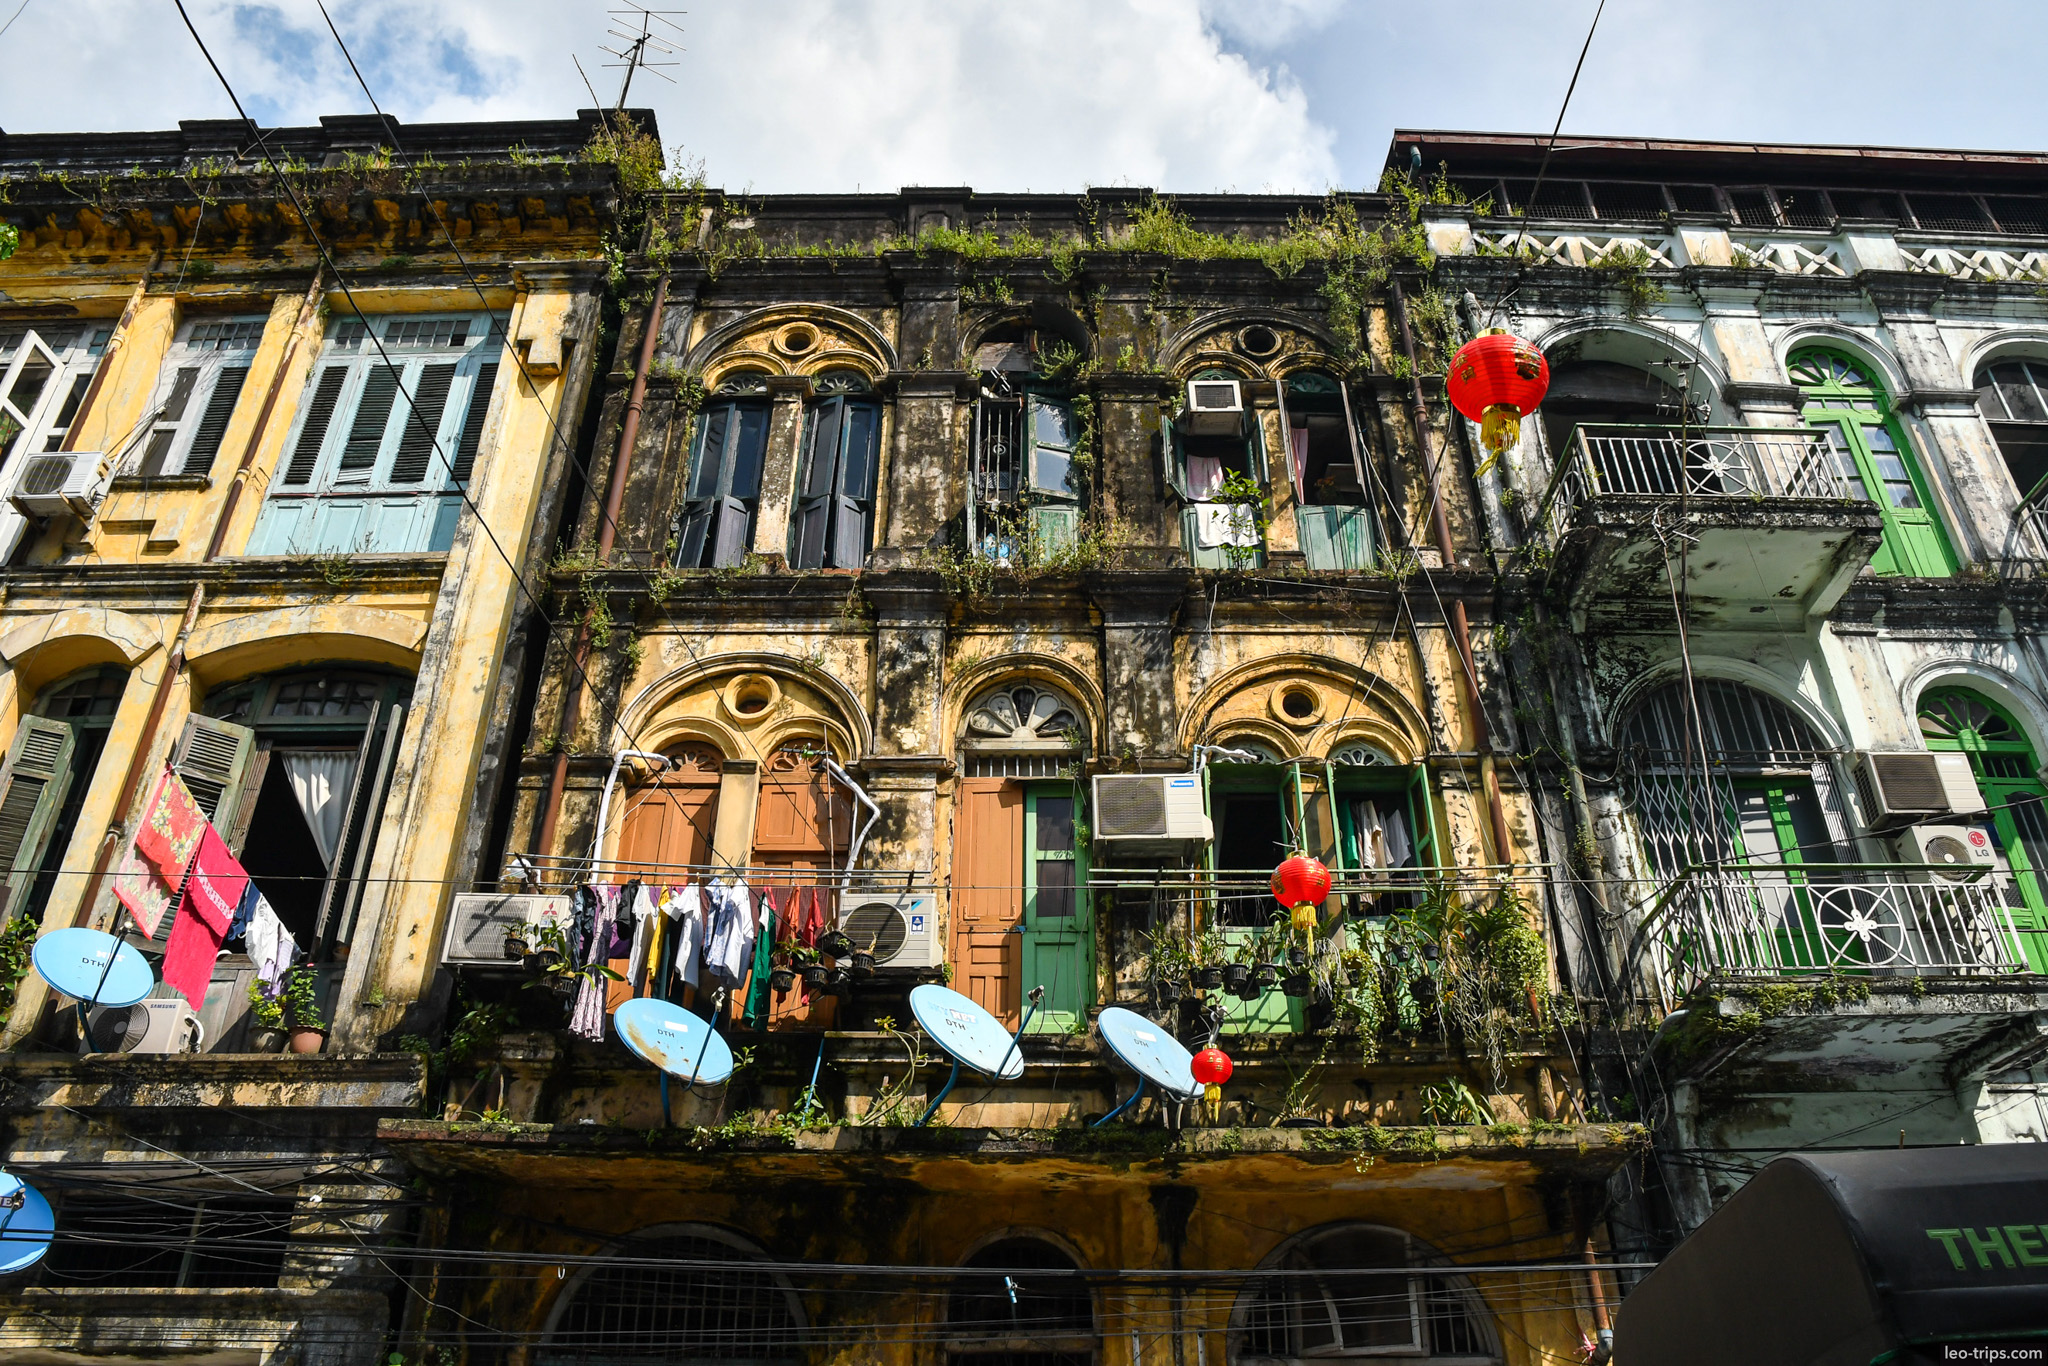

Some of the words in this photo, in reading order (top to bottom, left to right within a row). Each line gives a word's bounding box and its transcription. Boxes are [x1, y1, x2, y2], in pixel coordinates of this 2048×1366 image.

[1975, 849, 1989, 857] LG
[81, 957, 105, 968] DTH
[945, 1018, 966, 1031] DTH
[657, 1029, 675, 1038] DTH
[1133, 1038, 1149, 1048] DTH
[1925, 1224, 2048, 1270] THE
